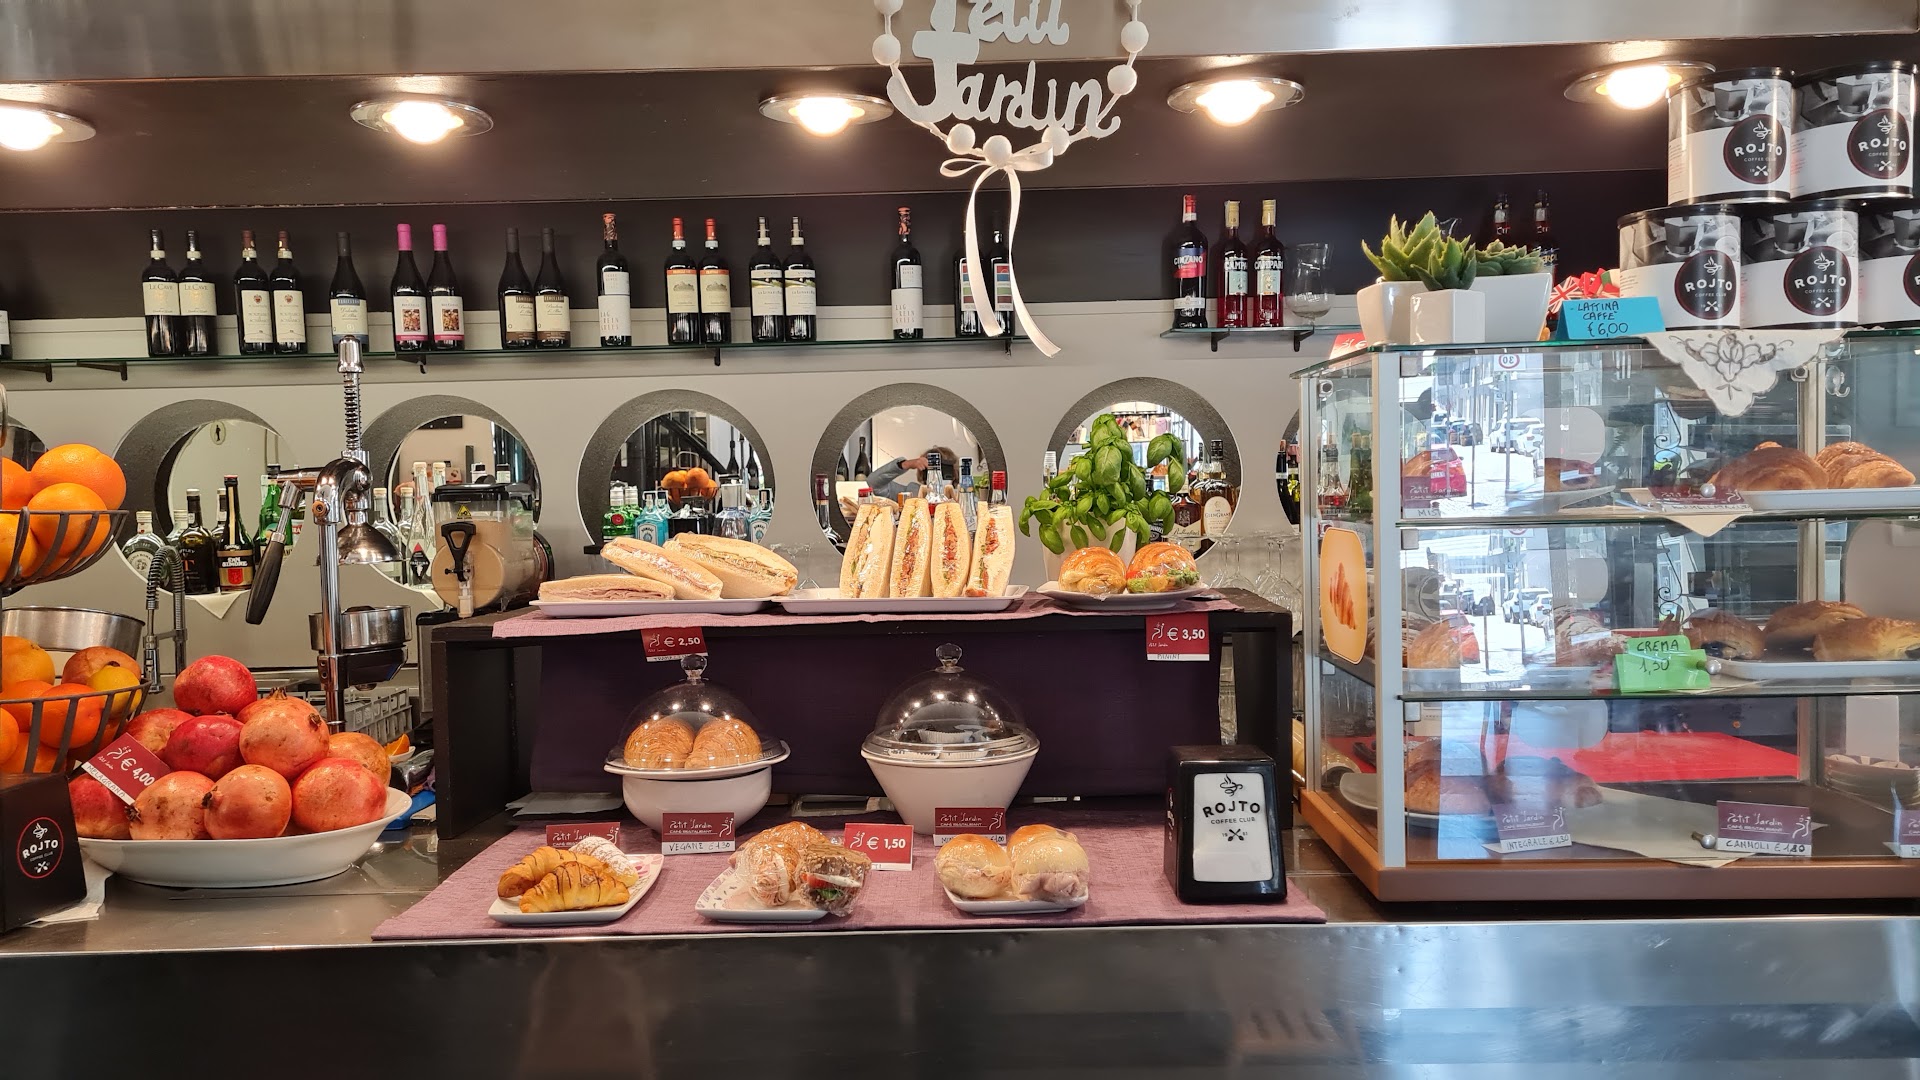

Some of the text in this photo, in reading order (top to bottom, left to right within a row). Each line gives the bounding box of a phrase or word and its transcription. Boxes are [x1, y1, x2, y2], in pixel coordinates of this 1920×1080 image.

[887, 31, 1121, 138] Jardin
[1733, 142, 1783, 157] ROJTO
[1858, 137, 1907, 152] ROJTO
[1173, 256, 1203, 265] CINZANO
[1254, 260, 1284, 270] CAMPARI
[1684, 278, 1733, 293] ROJTO
[1794, 274, 1847, 289] ROJTO
[1577, 301, 1620, 312] LATTINA
[1167, 627, 1206, 641] € 3,50
[663, 636, 701, 648] € 2,50
[1636, 640, 1679, 652] CREMA
[120, 757, 137, 771] €
[132, 767, 156, 786] 4,00
[1202, 800, 1261, 818] ROJTO
[1727, 812, 1783, 826] Petit Jardin
[22, 839, 59, 859] ROJTO
[669, 842, 704, 852] VEGANE
[867, 836, 906, 850] € 1,50
[1506, 836, 1548, 850] INTEGRALE
[1725, 840, 1770, 850] CANNOLI
